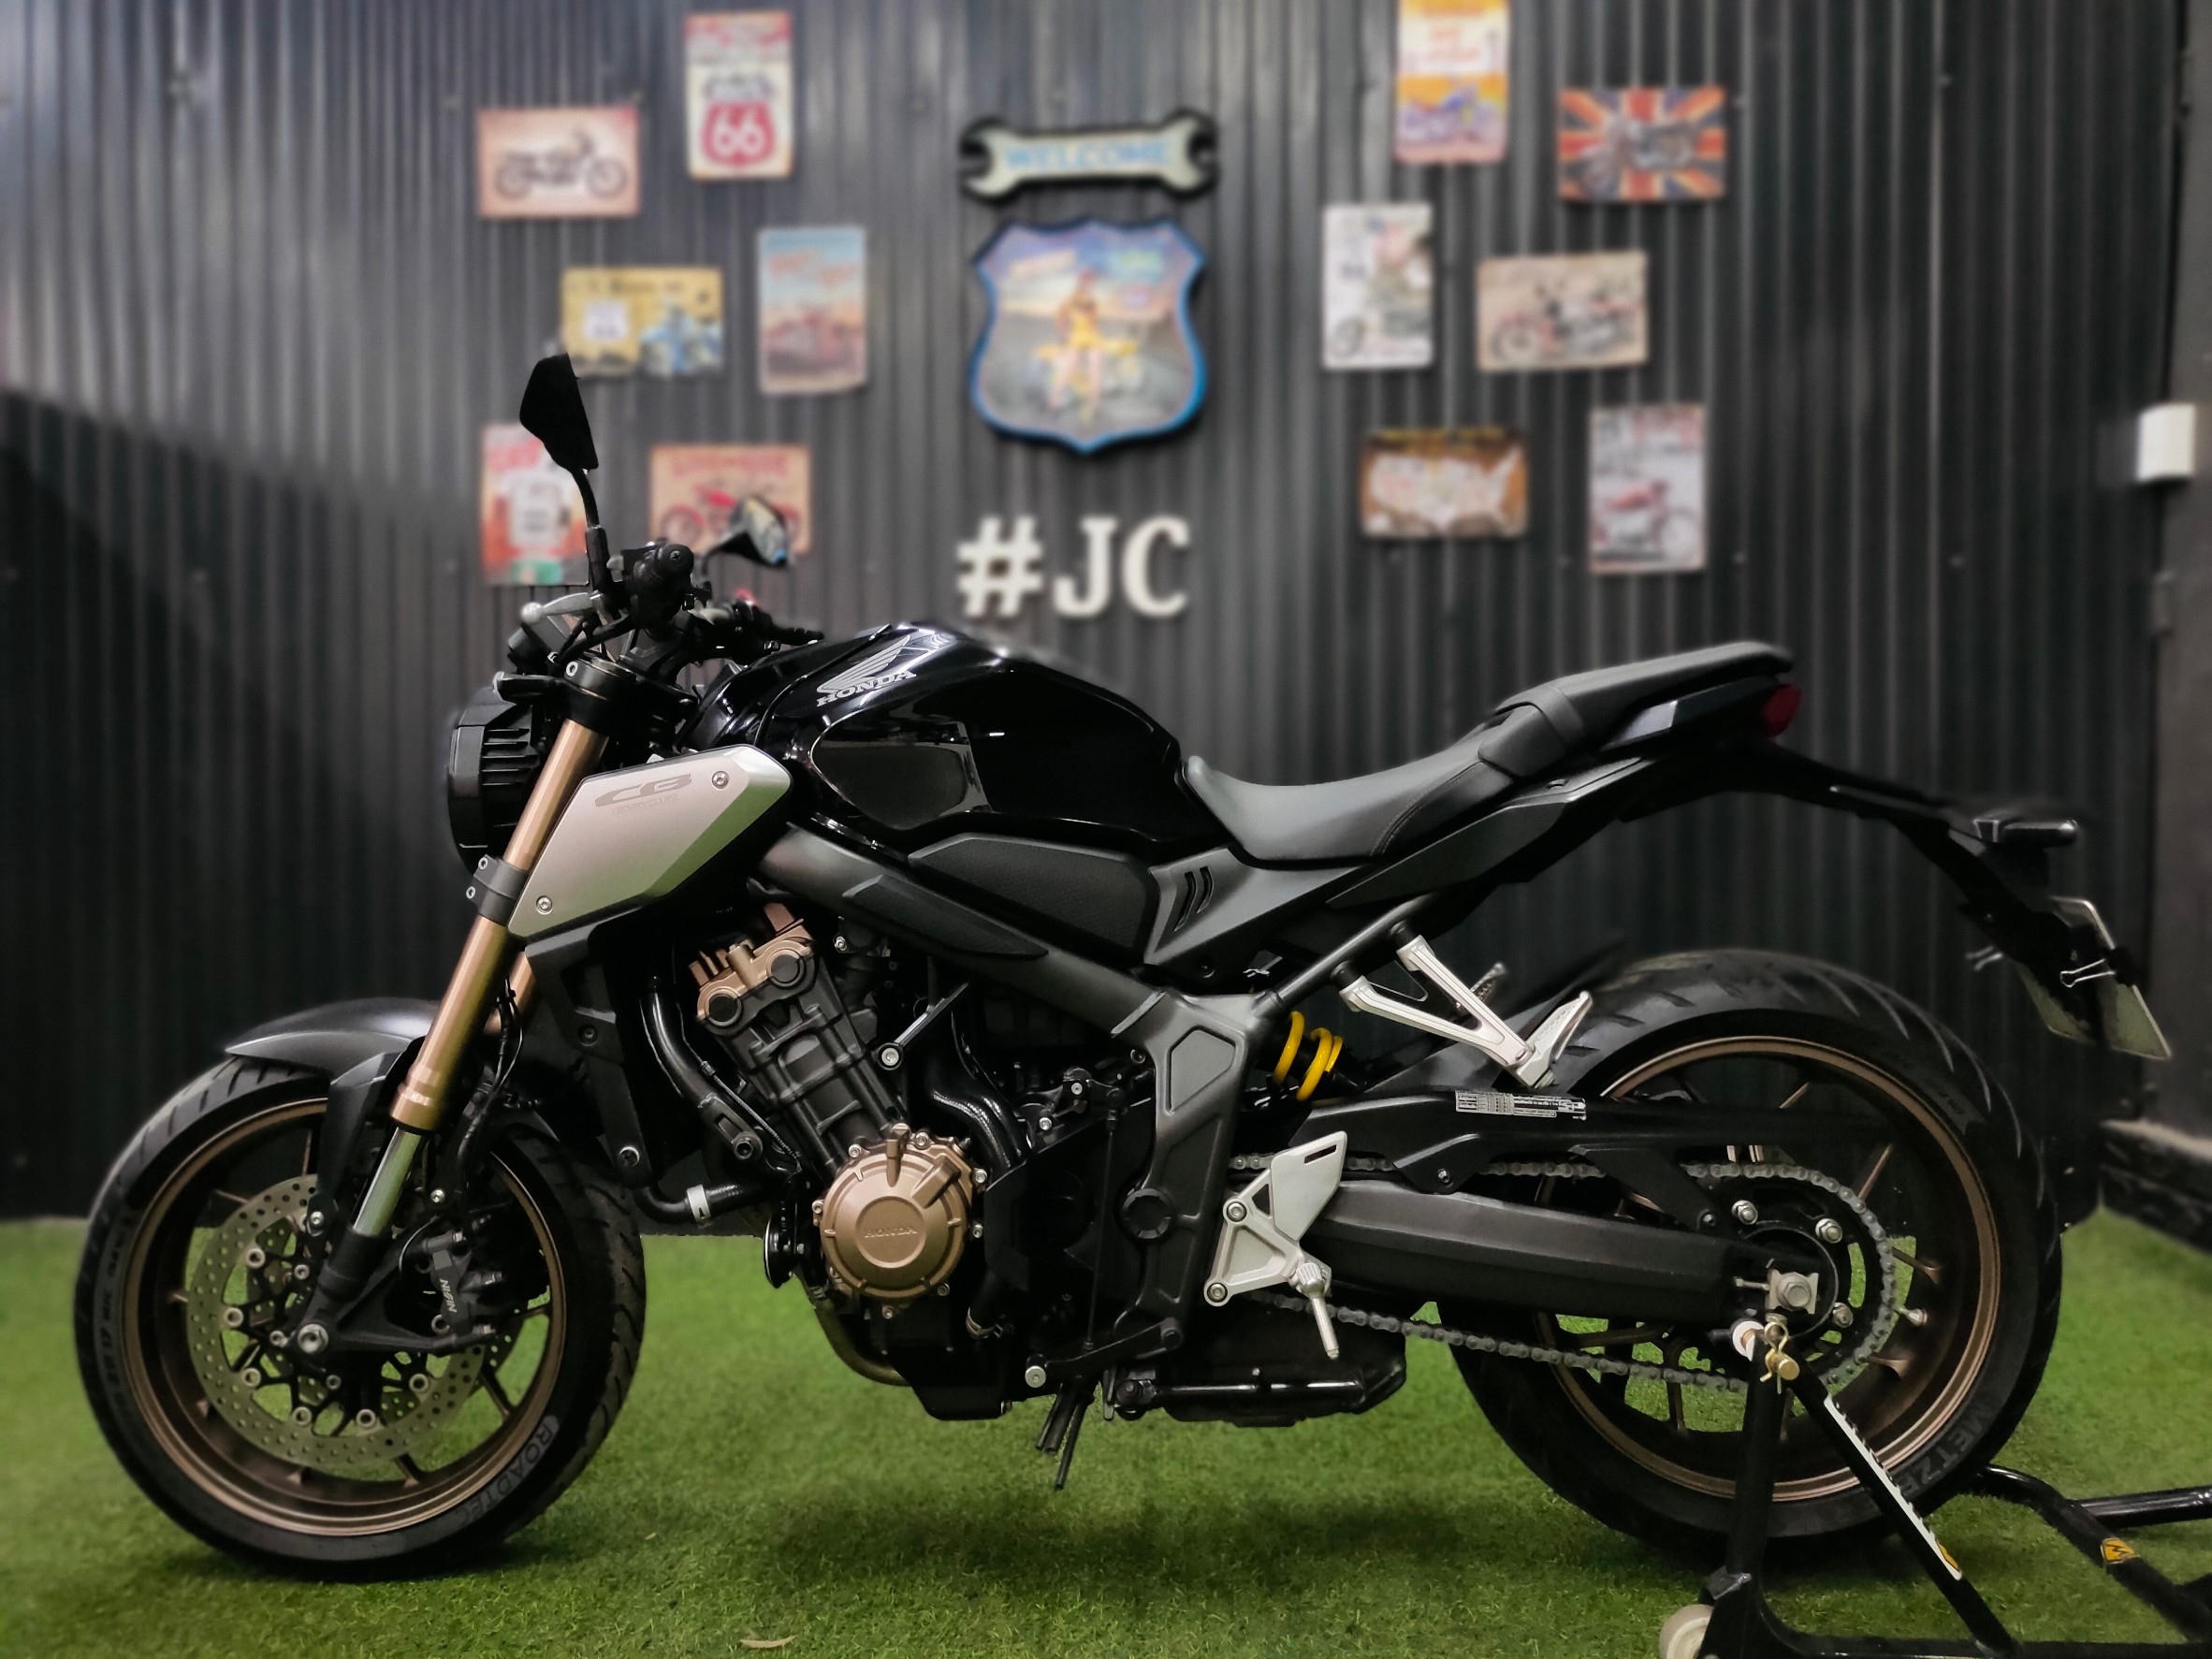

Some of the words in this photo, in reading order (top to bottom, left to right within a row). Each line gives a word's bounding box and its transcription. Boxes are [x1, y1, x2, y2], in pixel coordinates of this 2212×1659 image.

[713, 105, 771, 157] 66
[957, 516, 1189, 618] #JC
[816, 670, 917, 707] HONDA
[595, 774, 691, 807] CB
[863, 1226, 919, 1239] HONDA
[1892, 1403, 1995, 1497] METZE
